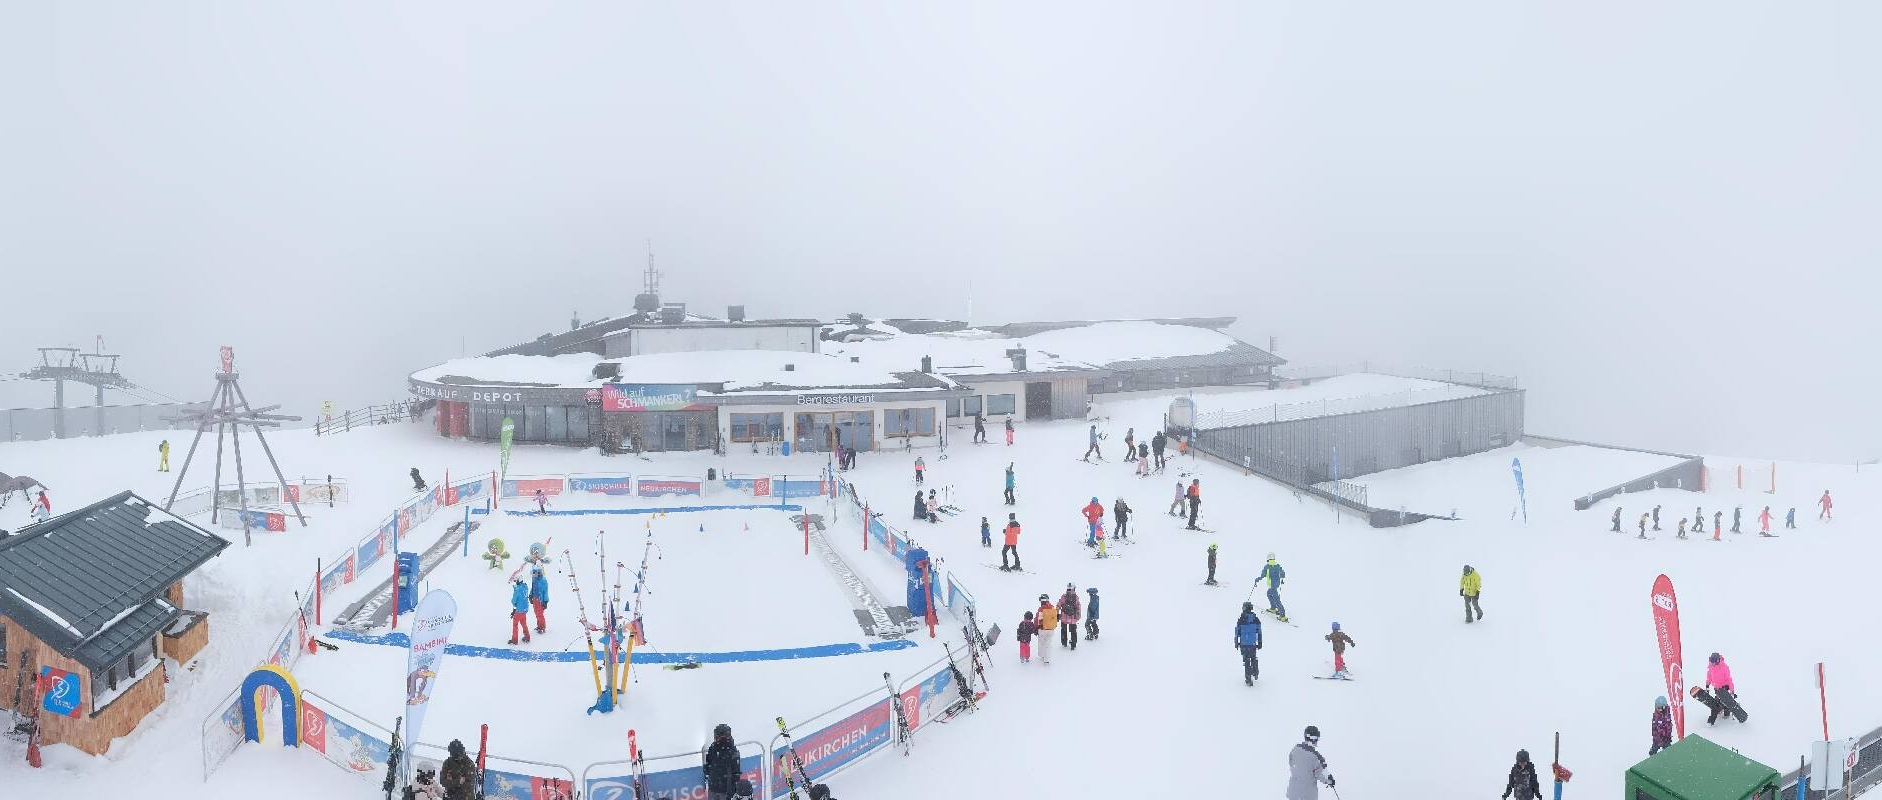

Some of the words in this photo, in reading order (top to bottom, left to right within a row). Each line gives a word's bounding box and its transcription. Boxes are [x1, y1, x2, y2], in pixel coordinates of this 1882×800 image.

[473, 391, 523, 402] DEPOT
[608, 388, 628, 401] Wild
[630, 386, 646, 398] auf
[797, 393, 875, 405] Bergrestaurant
[413, 637, 447, 653] BAMBINI
